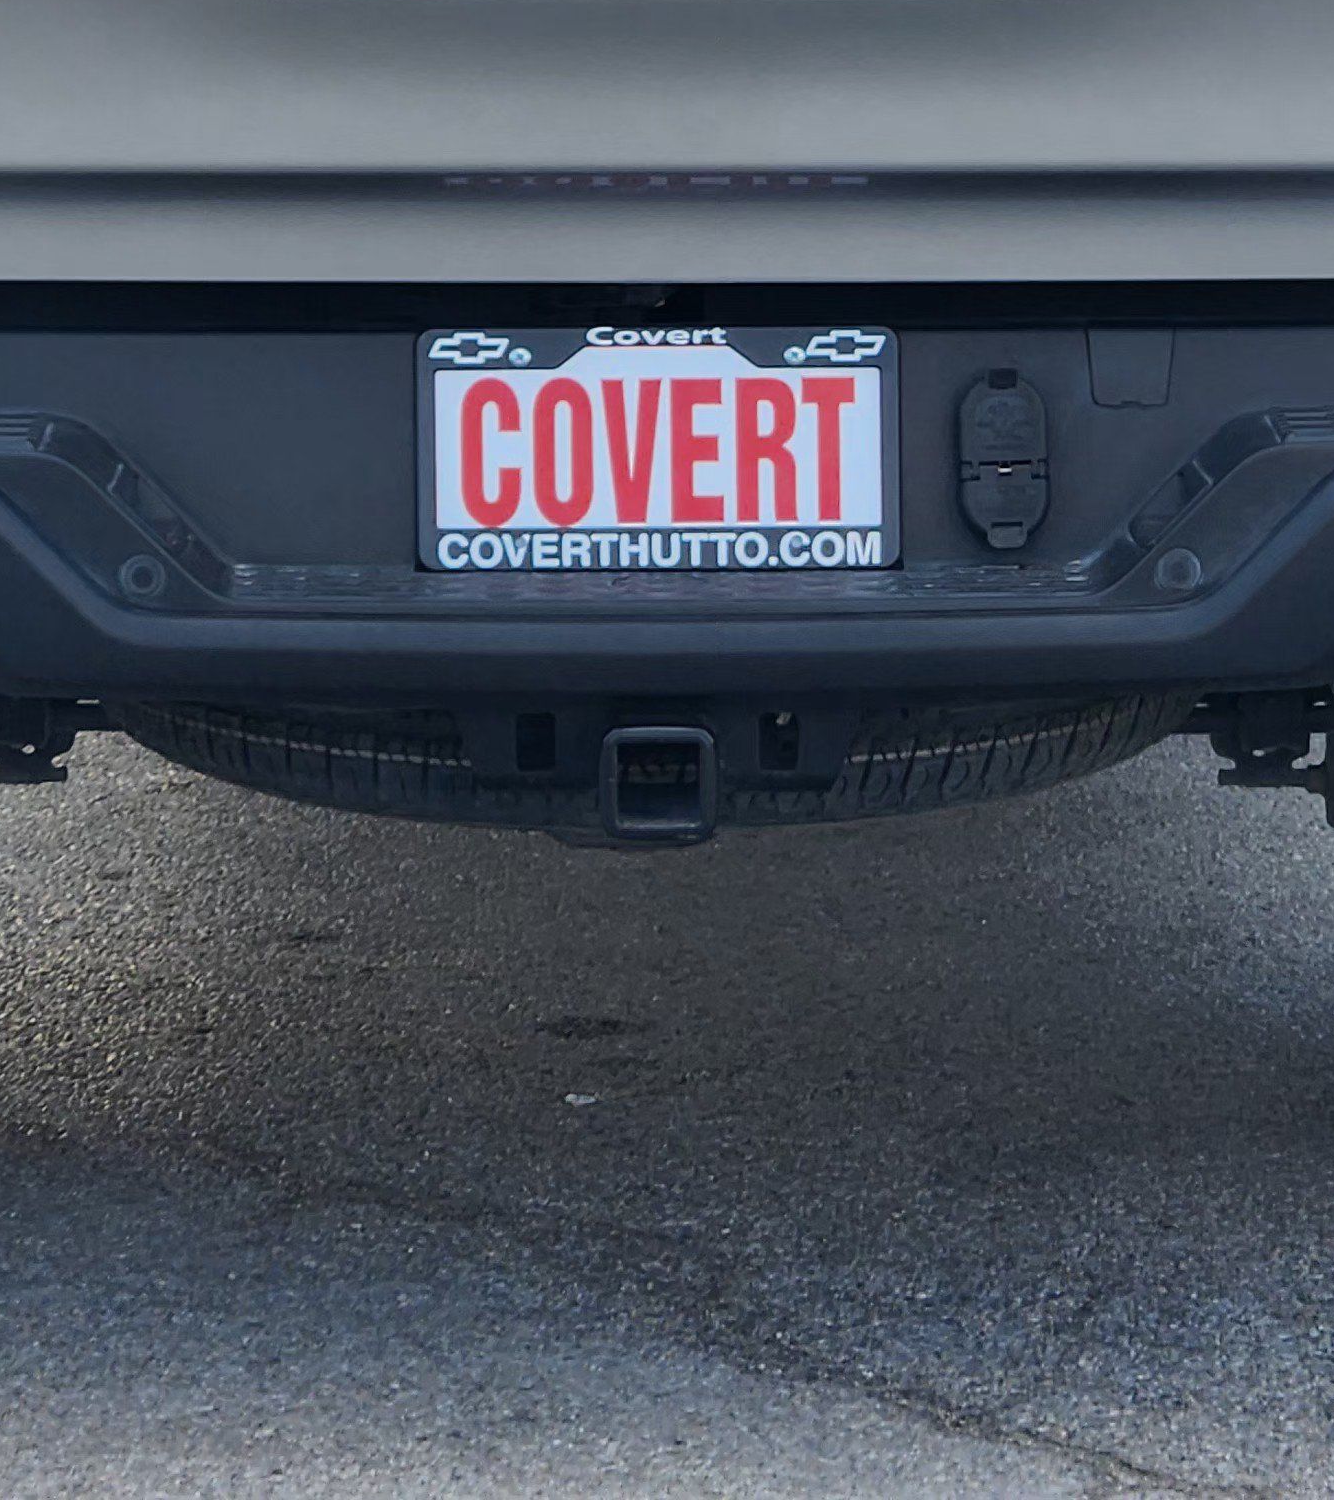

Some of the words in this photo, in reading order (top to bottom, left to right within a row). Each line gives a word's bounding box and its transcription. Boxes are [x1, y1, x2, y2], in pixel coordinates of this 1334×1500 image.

[585, 326, 727, 346] Covert
[460, 377, 856, 527] COVERT
[437, 531, 883, 568] COVERTHUTTO.COM
